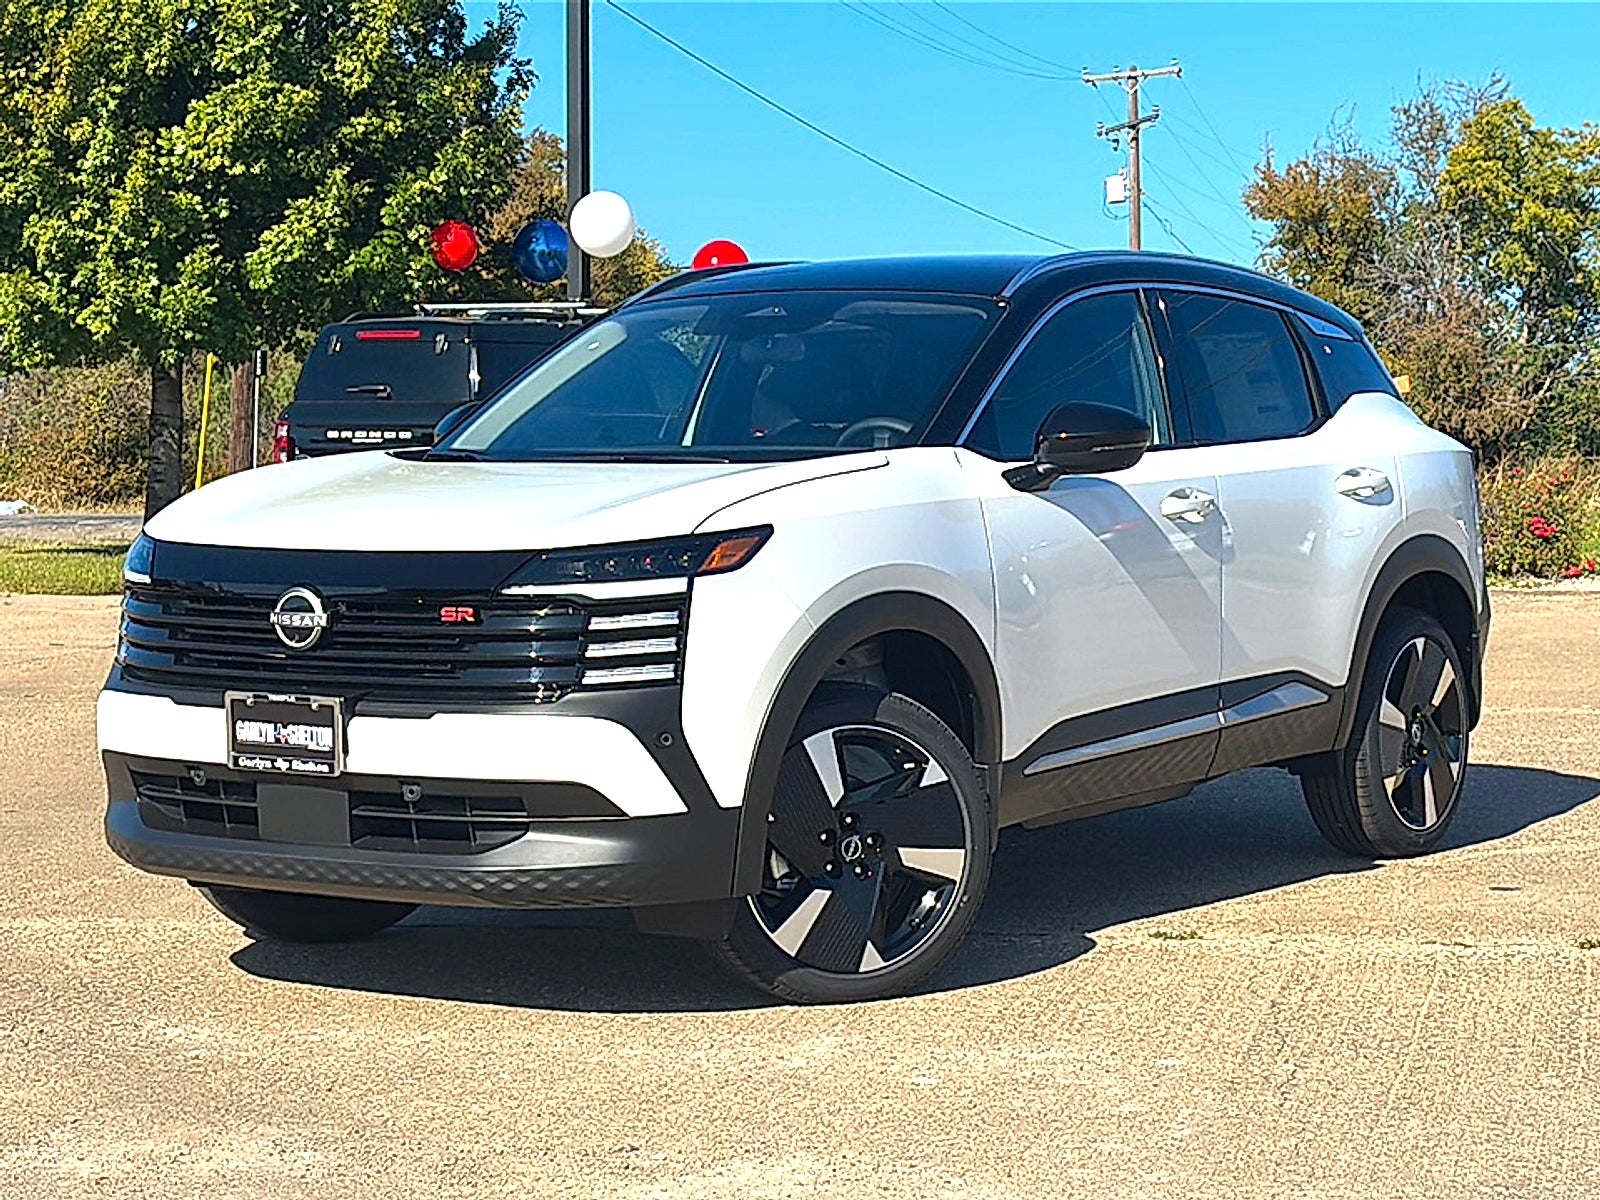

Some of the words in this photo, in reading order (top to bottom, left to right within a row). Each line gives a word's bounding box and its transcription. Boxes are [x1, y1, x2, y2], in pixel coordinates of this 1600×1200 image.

[326, 430, 412, 439] BRONCO
[270, 611, 328, 627] NISSAN
[440, 606, 475, 622] SR
